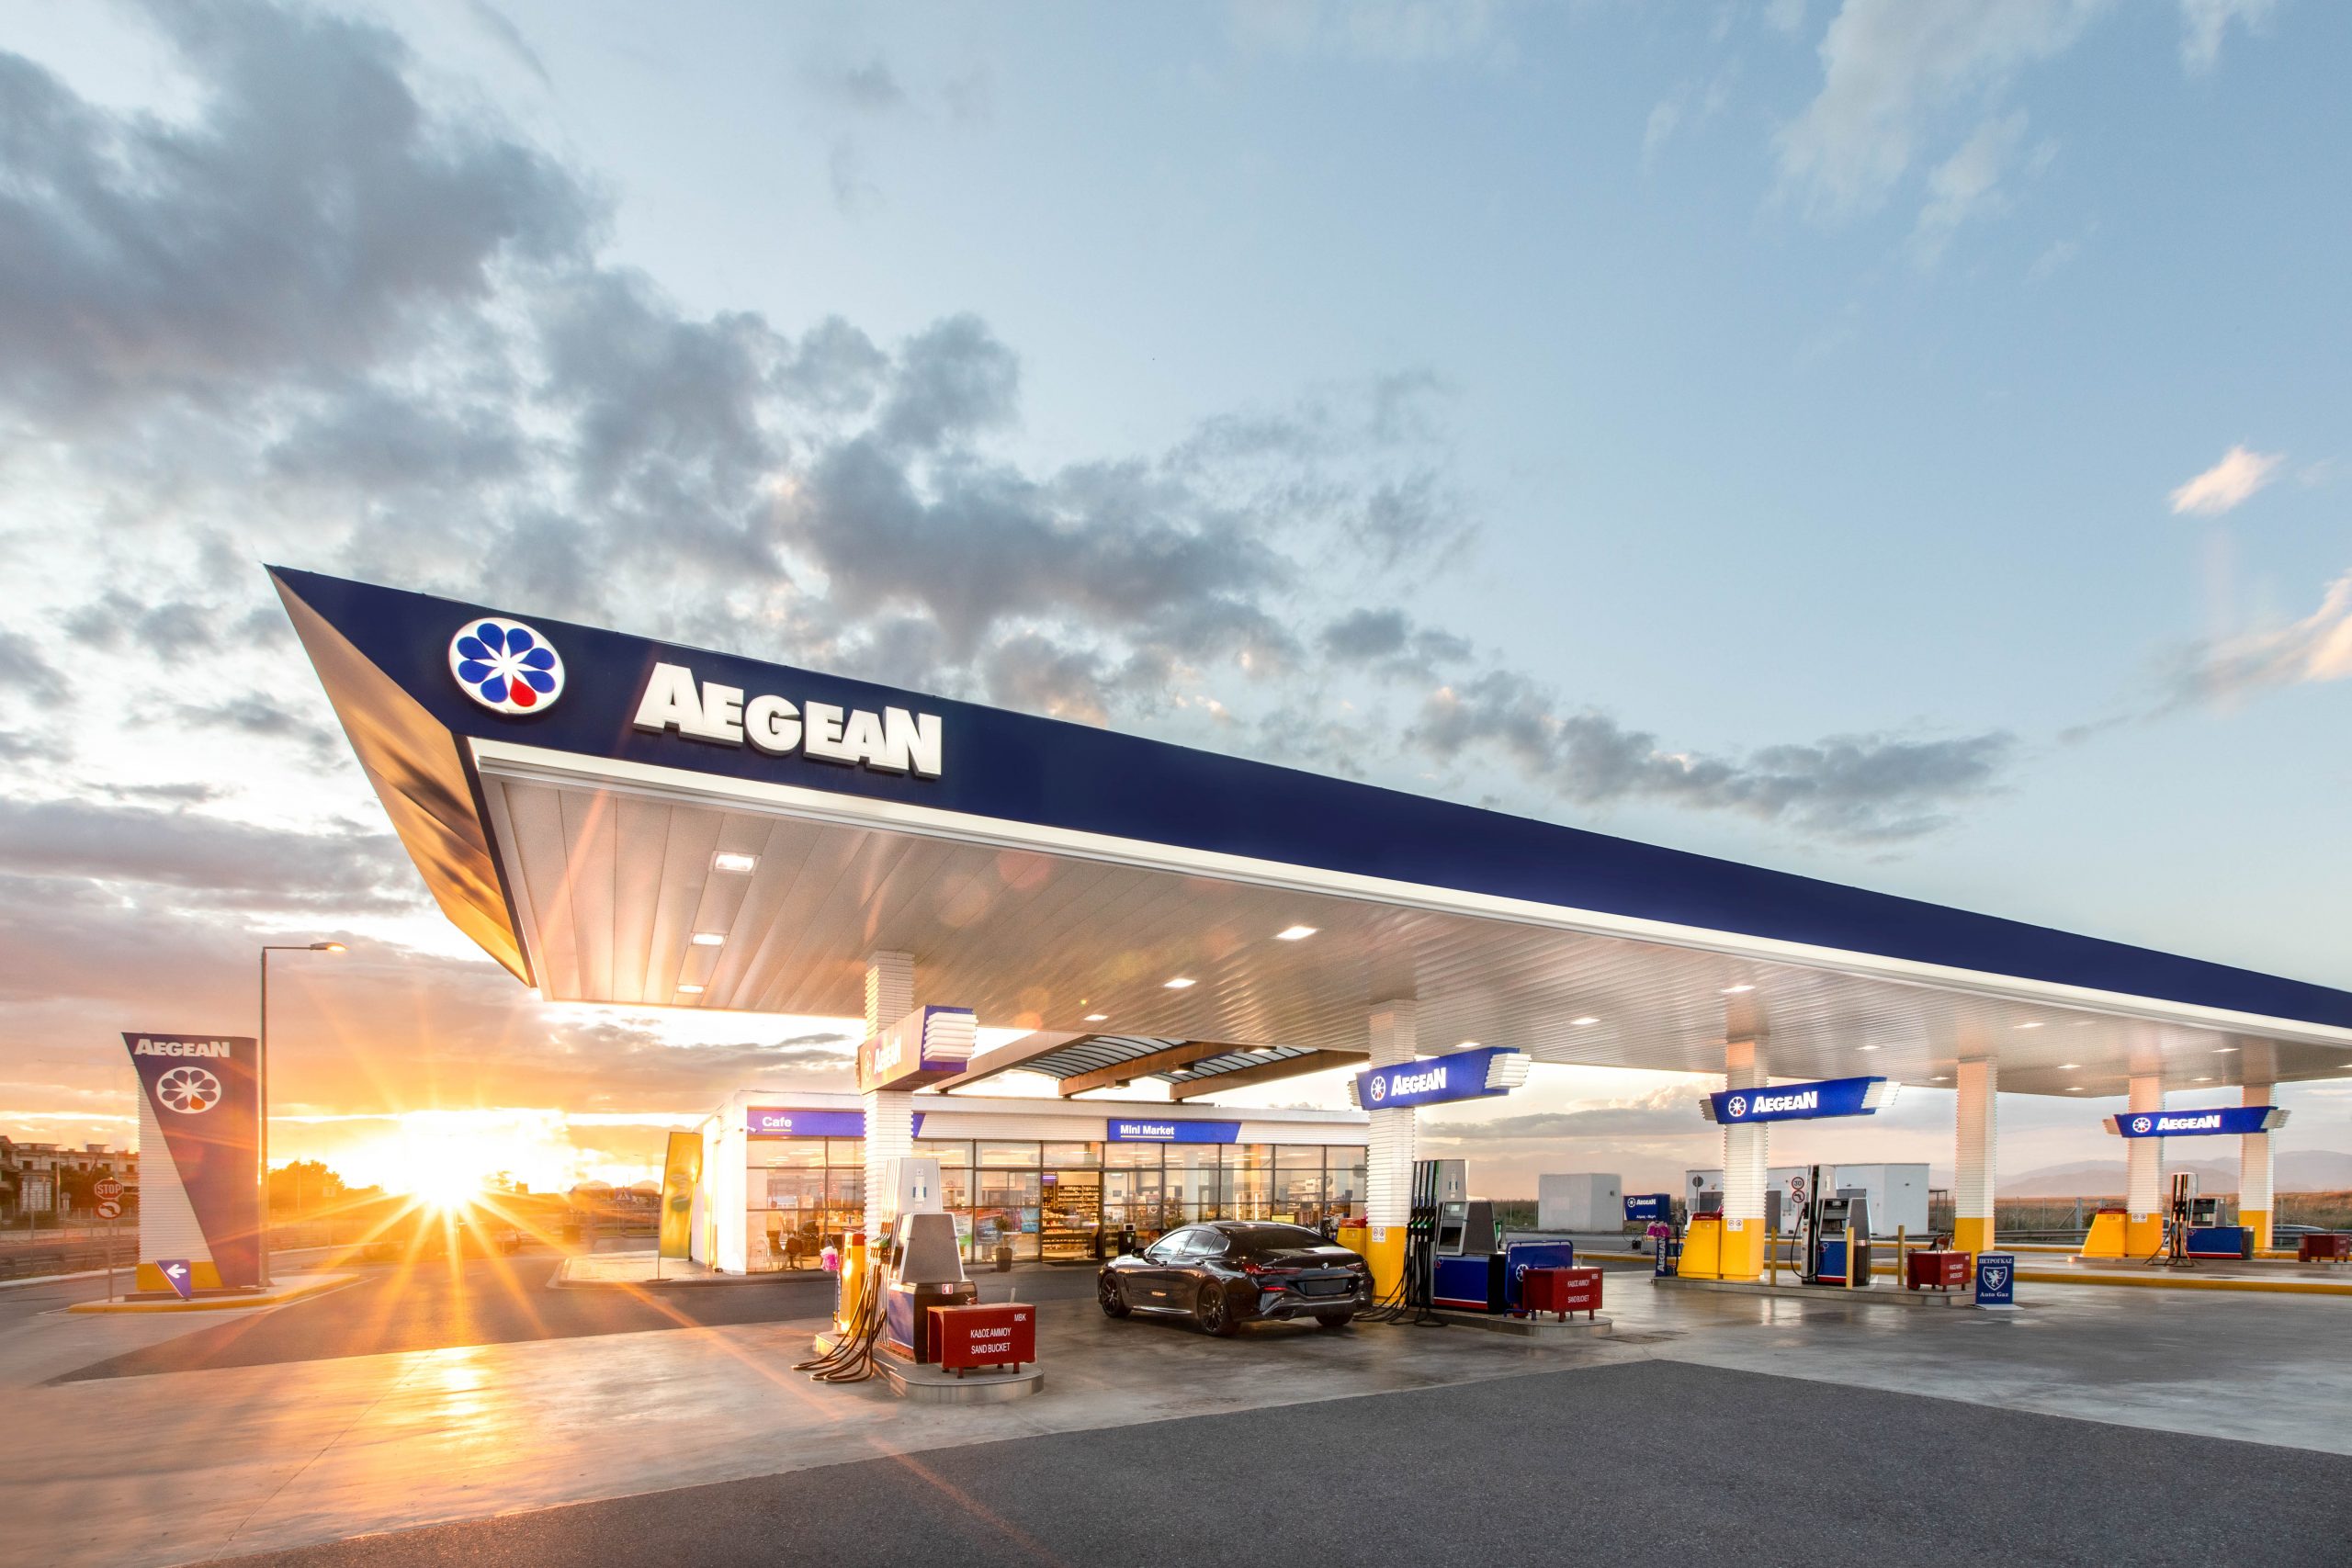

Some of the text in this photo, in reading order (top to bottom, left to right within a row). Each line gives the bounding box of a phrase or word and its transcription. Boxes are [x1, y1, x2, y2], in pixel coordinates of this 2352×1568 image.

[633, 661, 943, 779] AEGEAN
[134, 1038, 231, 1058] AEGEAN
[1390, 1066, 1447, 1097] AEGEAN
[1752, 1090, 1818, 1114] AEGEAN
[762, 1116, 793, 1128] Cafe
[2155, 1114, 2222, 1131] AEGEAN
[1120, 1124, 1175, 1135] Mini Market
[96, 1184, 121, 1194] STOP
[1657, 1236, 1666, 1272] AEGEAN
[1013, 1314, 1027, 1322] MBK
[970, 1327, 1011, 1338] ΚΑΔΟΣ ΑΜΜΟΥ
[971, 1343, 1011, 1354] SAND BUCKET
